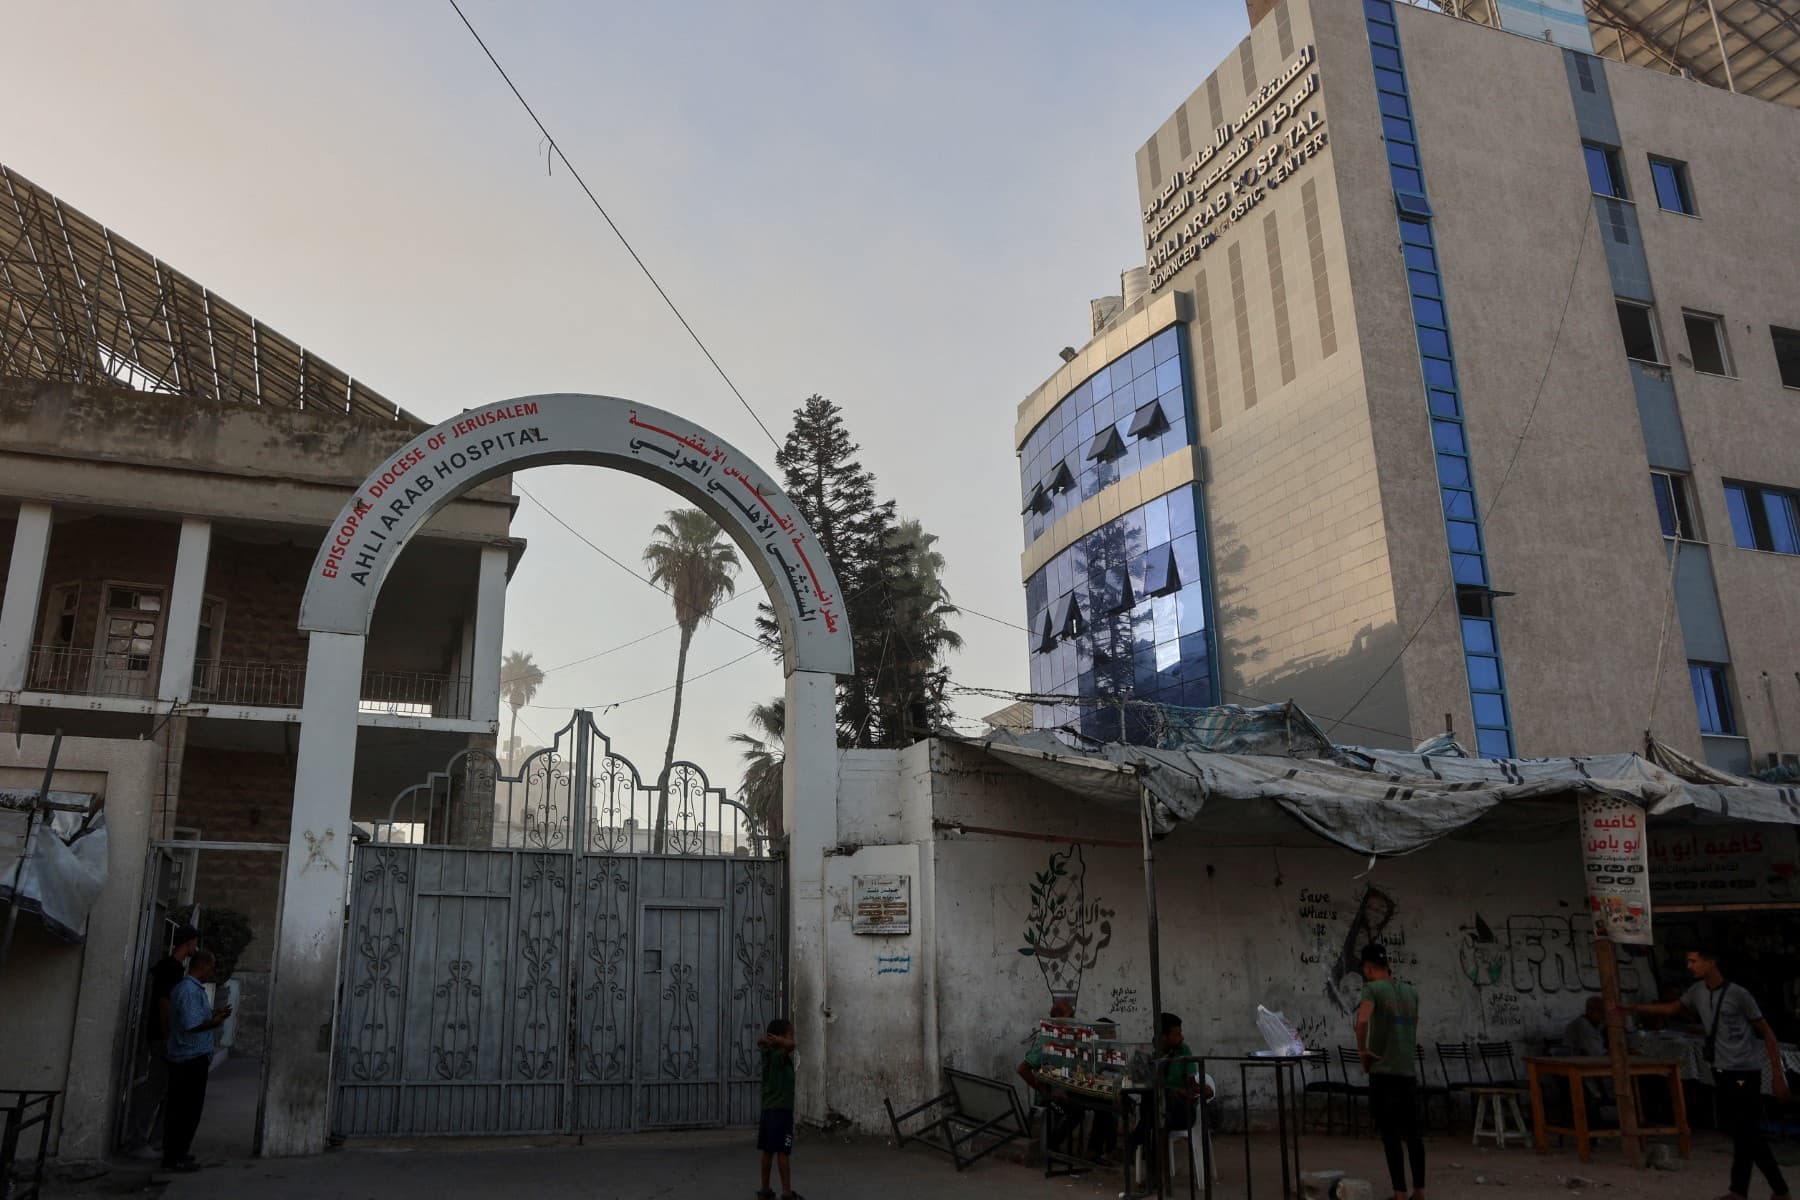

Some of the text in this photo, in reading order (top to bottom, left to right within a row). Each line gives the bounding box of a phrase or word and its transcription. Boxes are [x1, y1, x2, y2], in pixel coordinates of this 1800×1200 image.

[1232, 45, 1313, 133] المستشفى
[1271, 73, 1316, 134] المركز
[1143, 172, 1182, 223] العربي
[1145, 191, 1191, 249] المتطور
[1148, 111, 1321, 275] AHLI ARAB HOSPTAL
[1150, 244, 1198, 293] ADVANCED
[629, 436, 713, 478] العربي
[322, 402, 539, 579] EPISCOPAL DIOCESE OF JERUSALEM
[350, 426, 549, 587] AHLI ARAB HOSPITAL
[1593, 813, 1637, 832] كافيه
[1299, 888, 1331, 903] Save
[1507, 912, 1642, 993] FRE
